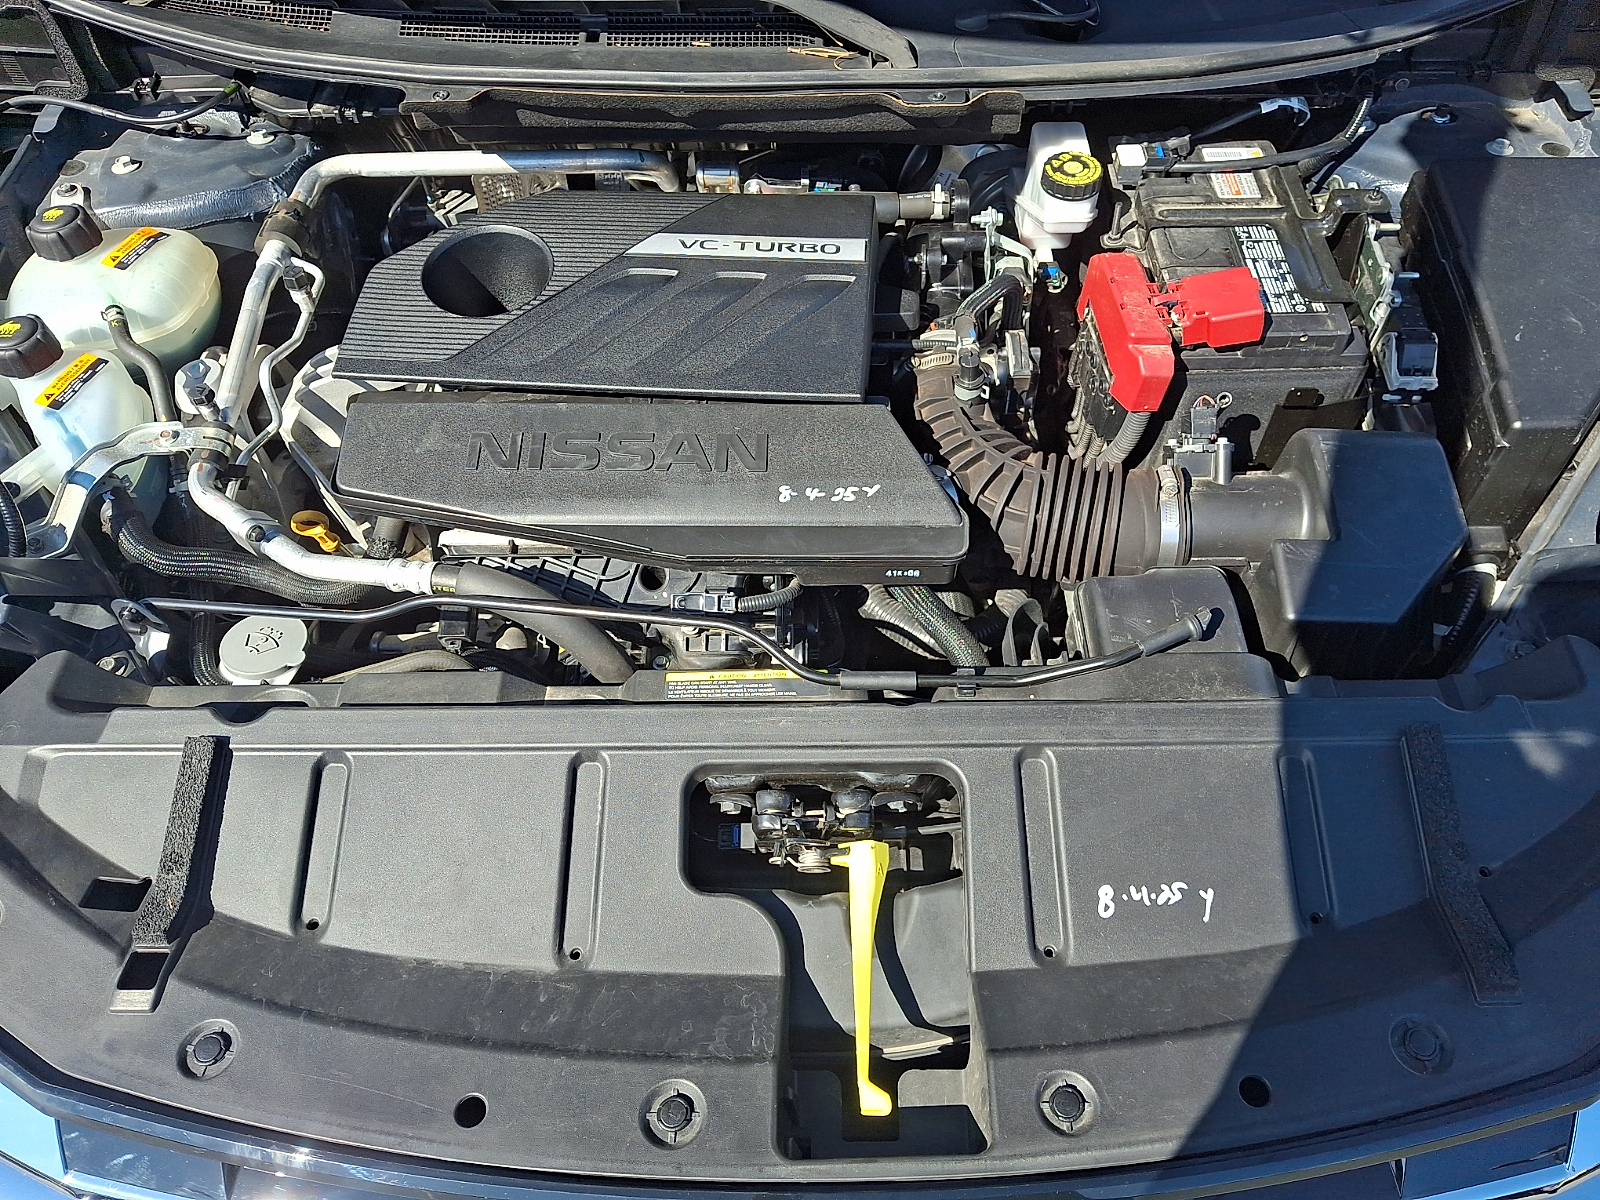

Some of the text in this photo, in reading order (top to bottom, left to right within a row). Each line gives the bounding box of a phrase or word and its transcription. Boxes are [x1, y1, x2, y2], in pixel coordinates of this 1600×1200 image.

[677, 238, 842, 254] VC-TURBO
[463, 431, 769, 473] NISSAN
[876, 862, 885, 877] A
